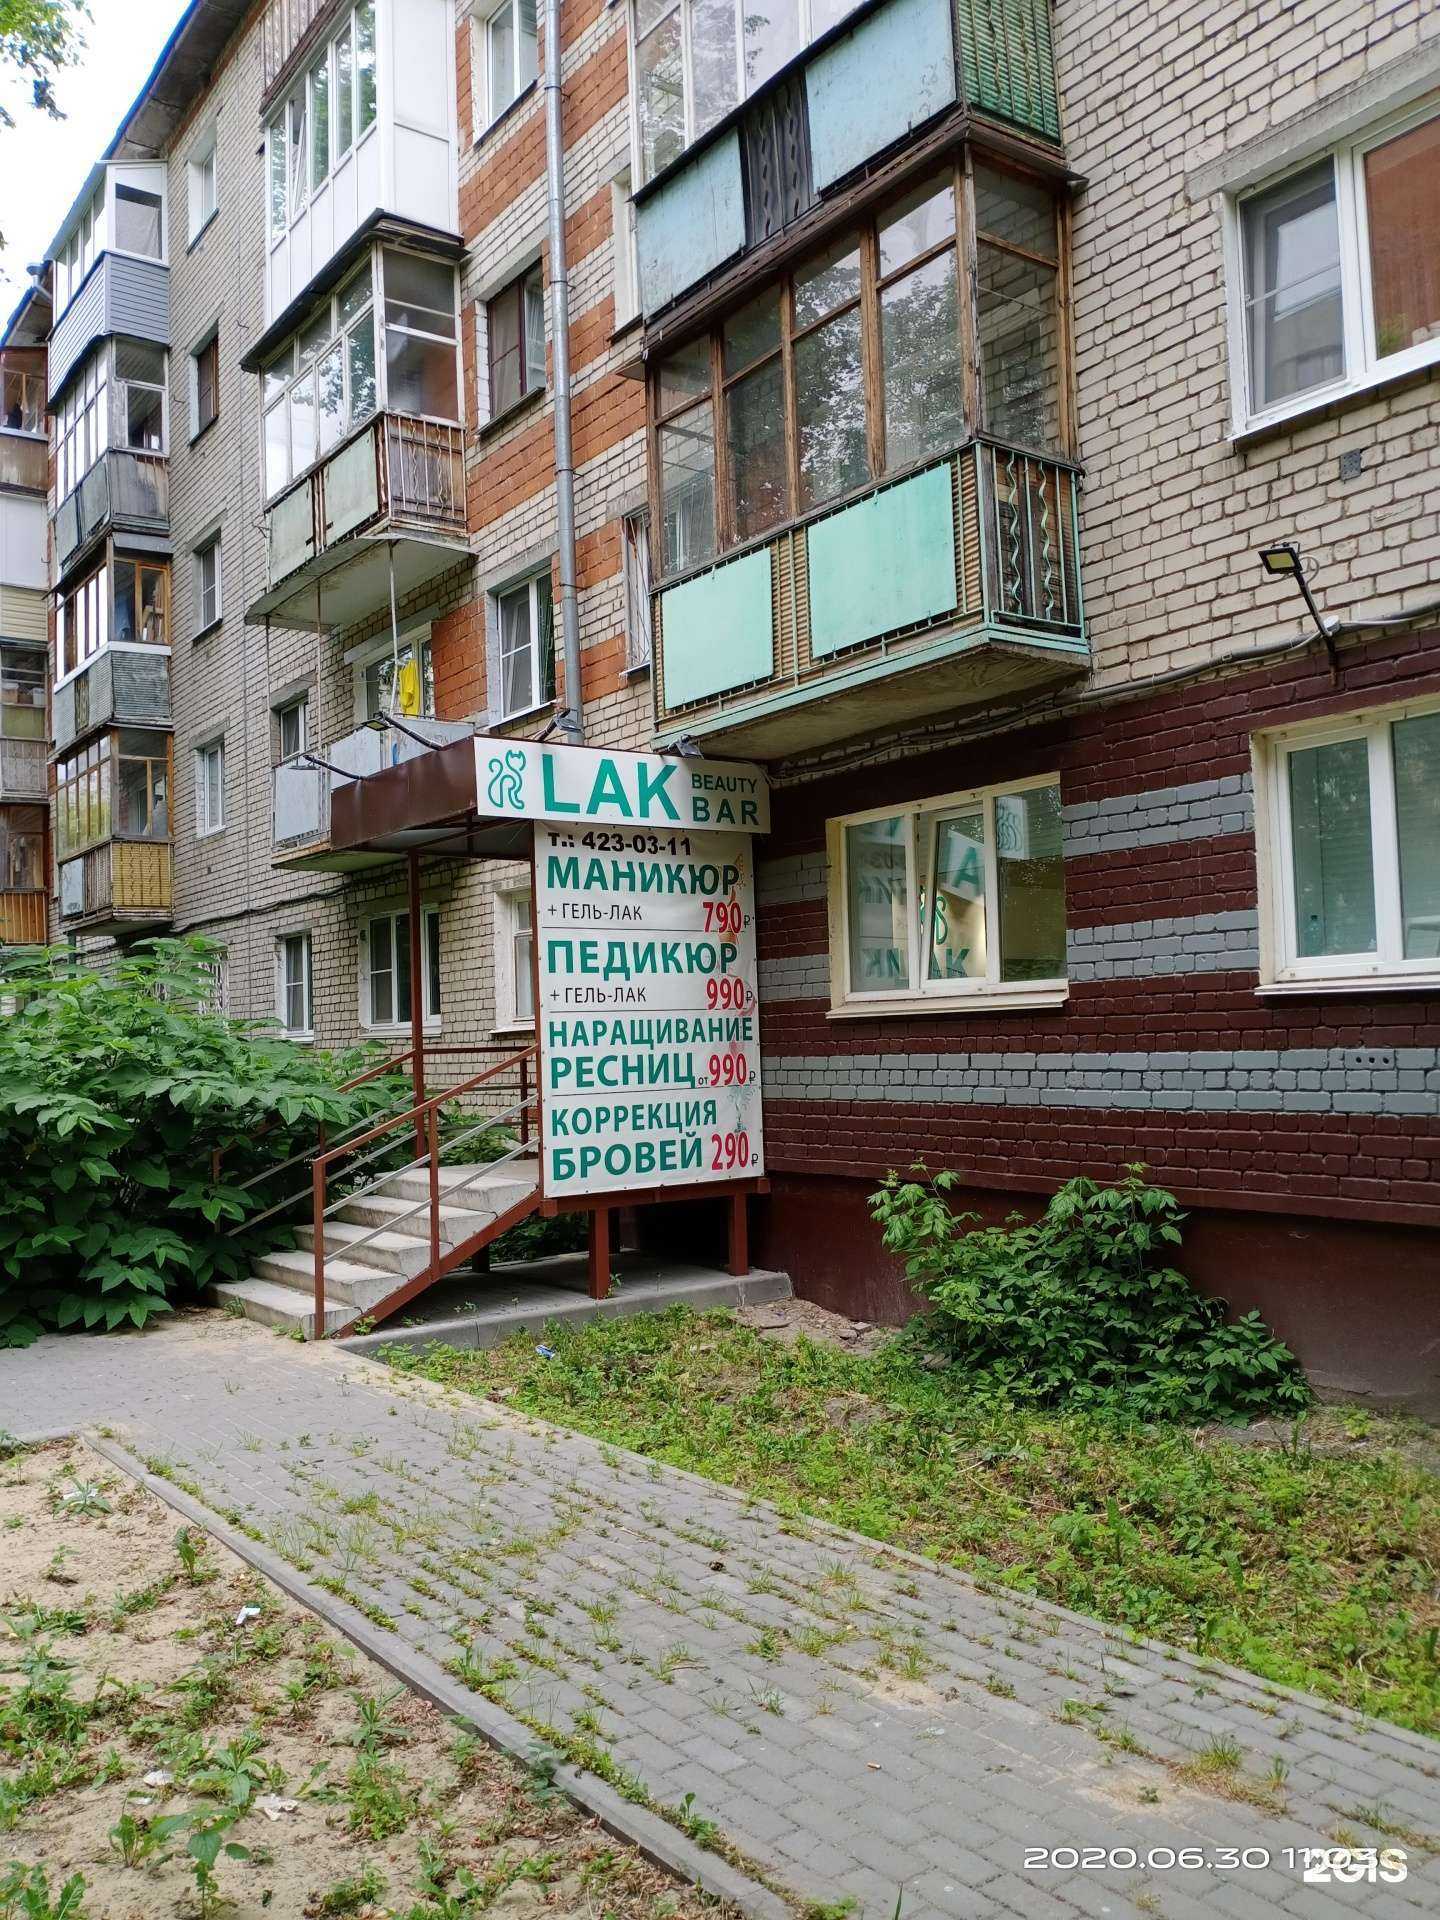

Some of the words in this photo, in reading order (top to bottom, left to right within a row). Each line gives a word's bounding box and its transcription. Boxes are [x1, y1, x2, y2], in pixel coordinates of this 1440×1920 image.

[542, 754, 680, 820] LAK
[691, 773, 757, 793] BEAUTY
[692, 797, 759, 825] BAR
[582, 831, 691, 855] 423-03-11
[547, 856, 739, 895] МАНИКЮР
[562, 903, 642, 920] ГЕЛЬ-ЛАК
[548, 940, 737, 981] ПЕДИКЮР
[565, 987, 646, 1003] ГЕЛЬ-ЛАК
[549, 1017, 753, 1049] НАРАЩИВАНИЕ
[551, 1052, 695, 1089] РЕСНИЦ
[552, 1099, 717, 1136] КОРРЕКЦИЯ
[552, 1131, 702, 1181] БРОВЕЙ
